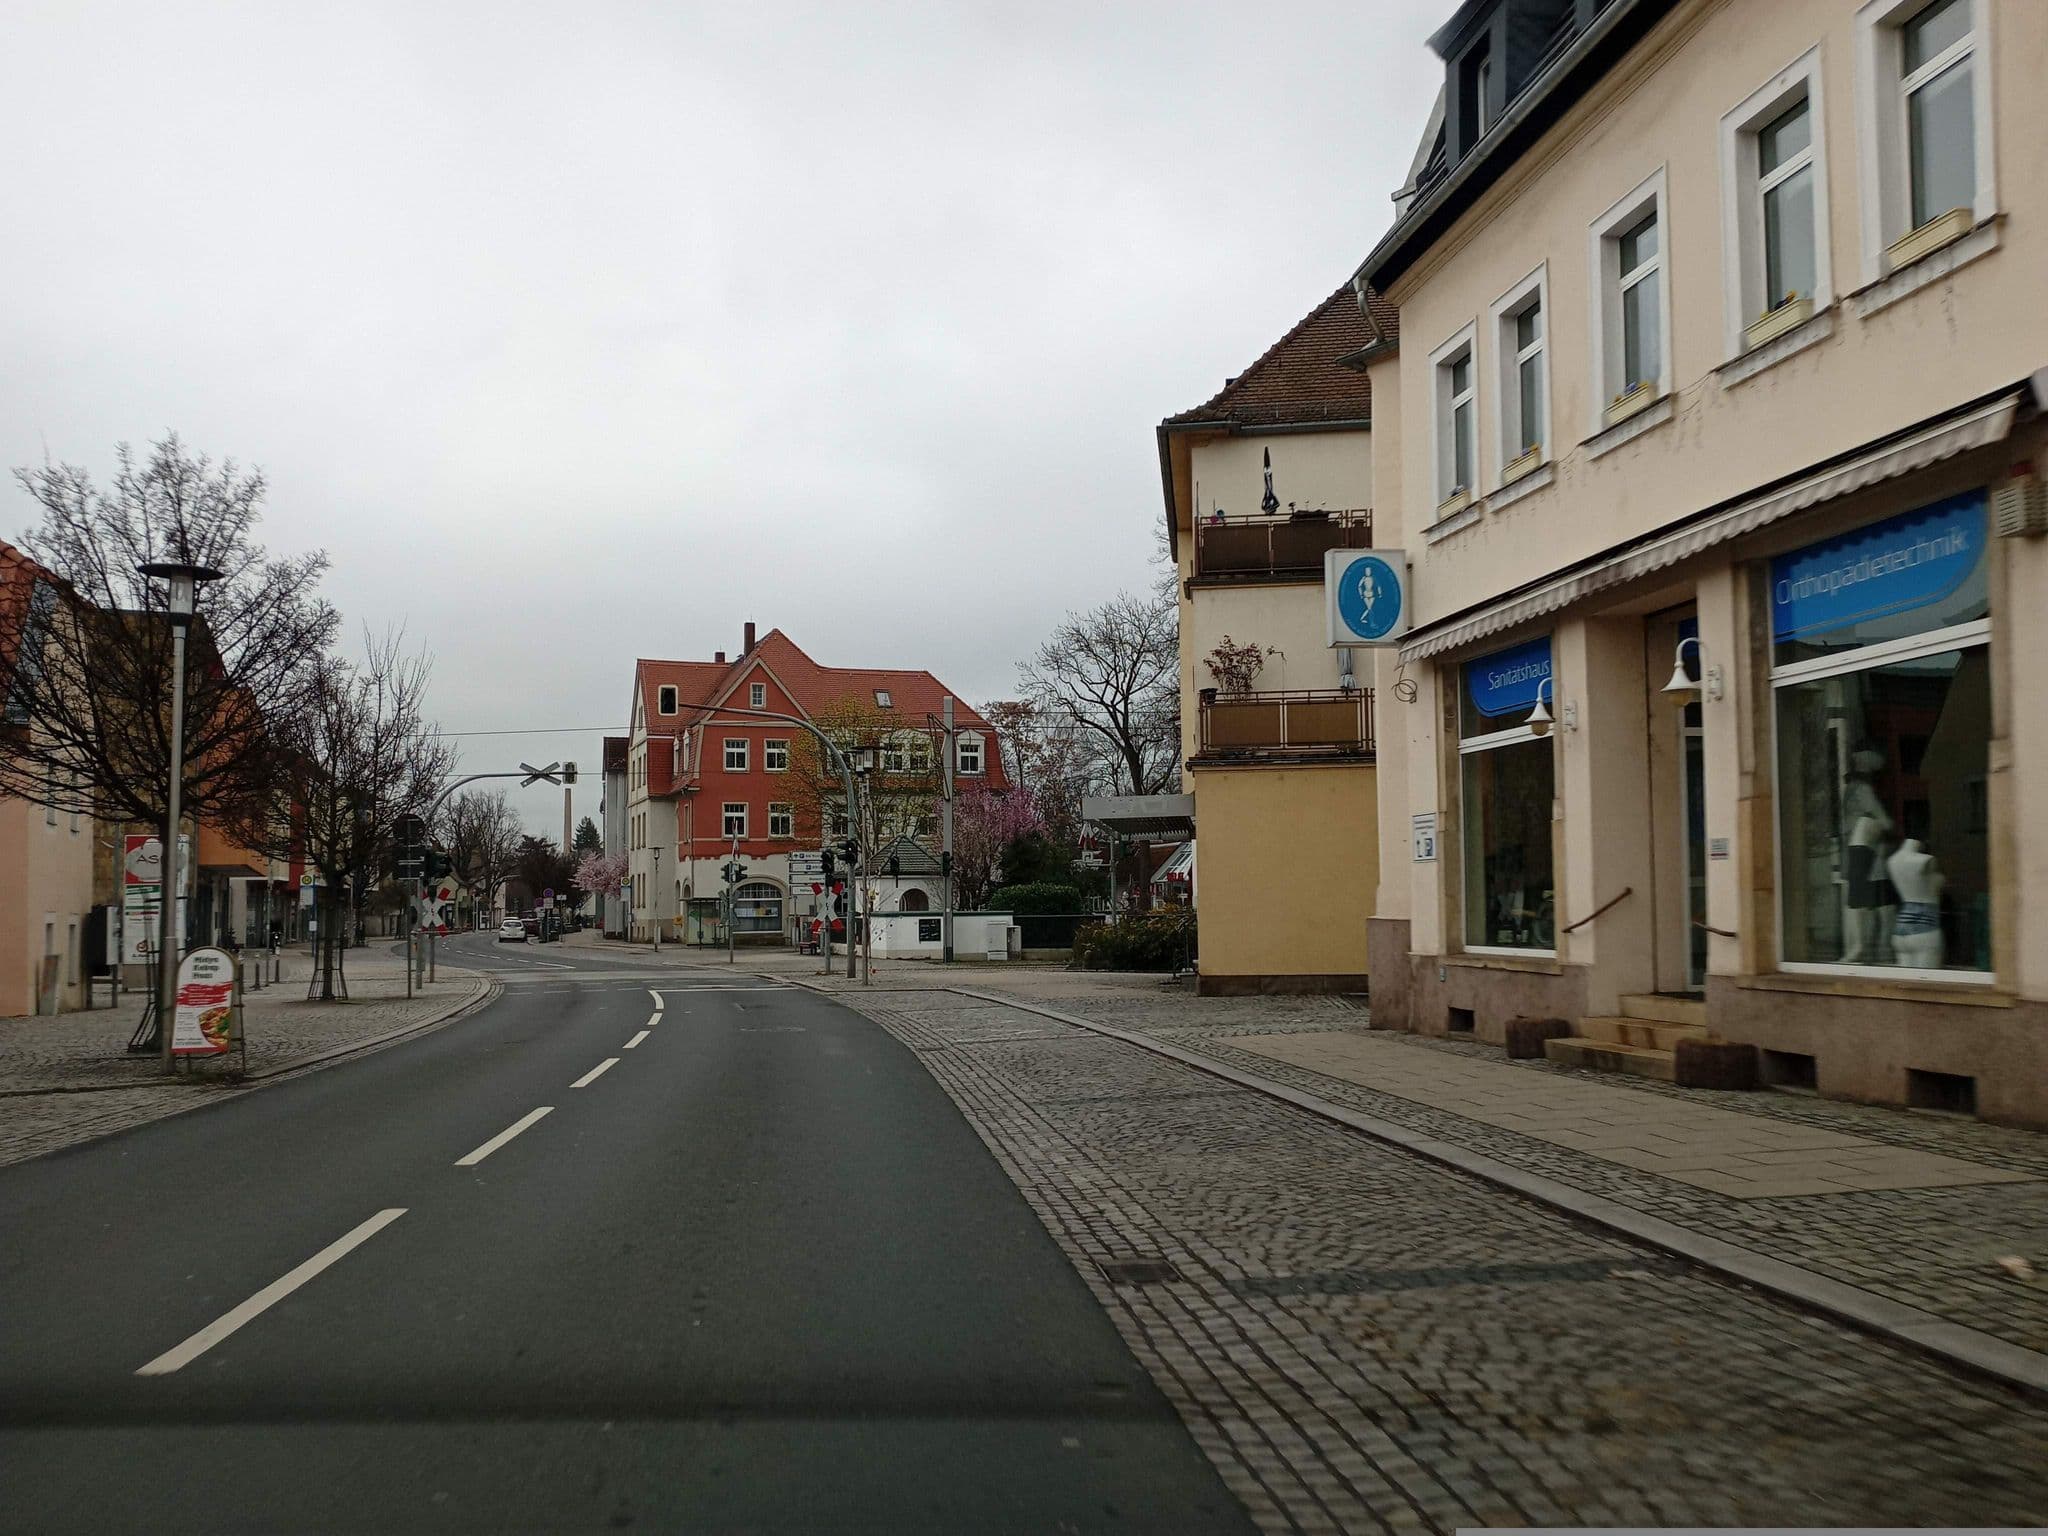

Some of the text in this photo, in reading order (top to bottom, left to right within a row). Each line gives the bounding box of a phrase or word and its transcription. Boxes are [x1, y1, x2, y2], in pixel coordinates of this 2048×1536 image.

[1776, 524, 1969, 604] Orthopädietechnik
[1488, 659, 1550, 691] Sanitätshaus
[136, 855, 160, 864] AS
